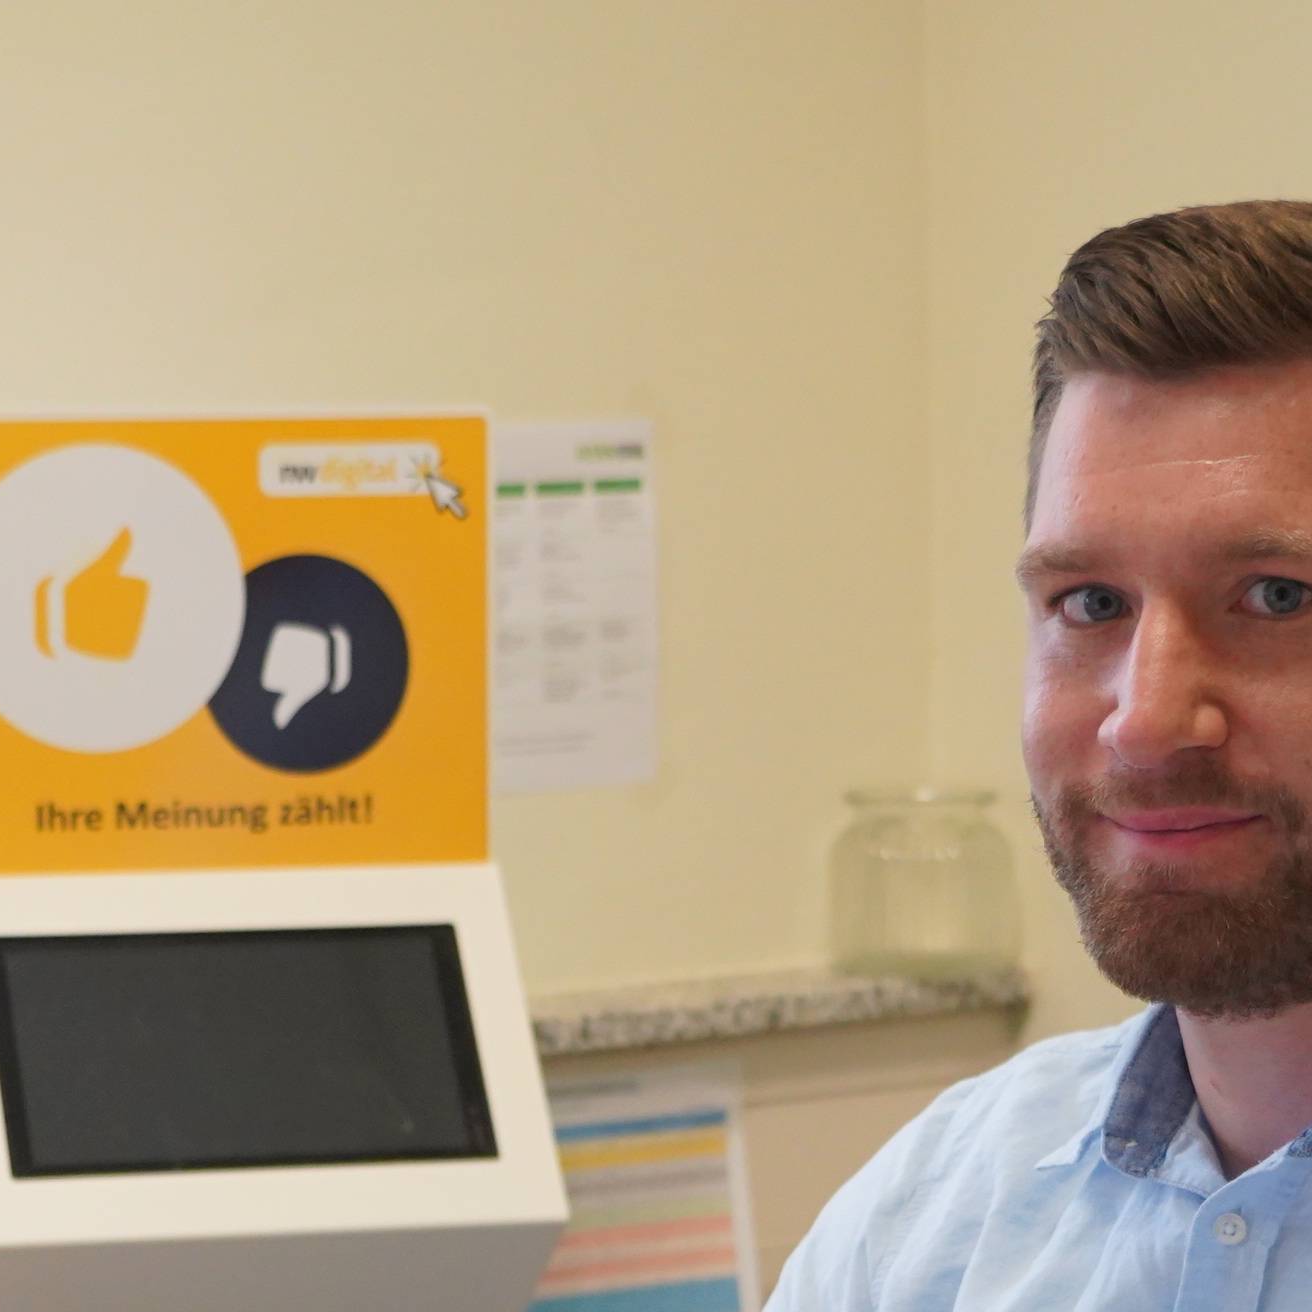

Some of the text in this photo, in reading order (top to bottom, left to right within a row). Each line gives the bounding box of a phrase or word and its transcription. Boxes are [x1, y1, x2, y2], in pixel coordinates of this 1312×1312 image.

[35, 793, 375, 835] Ihre Meinung zählt!
